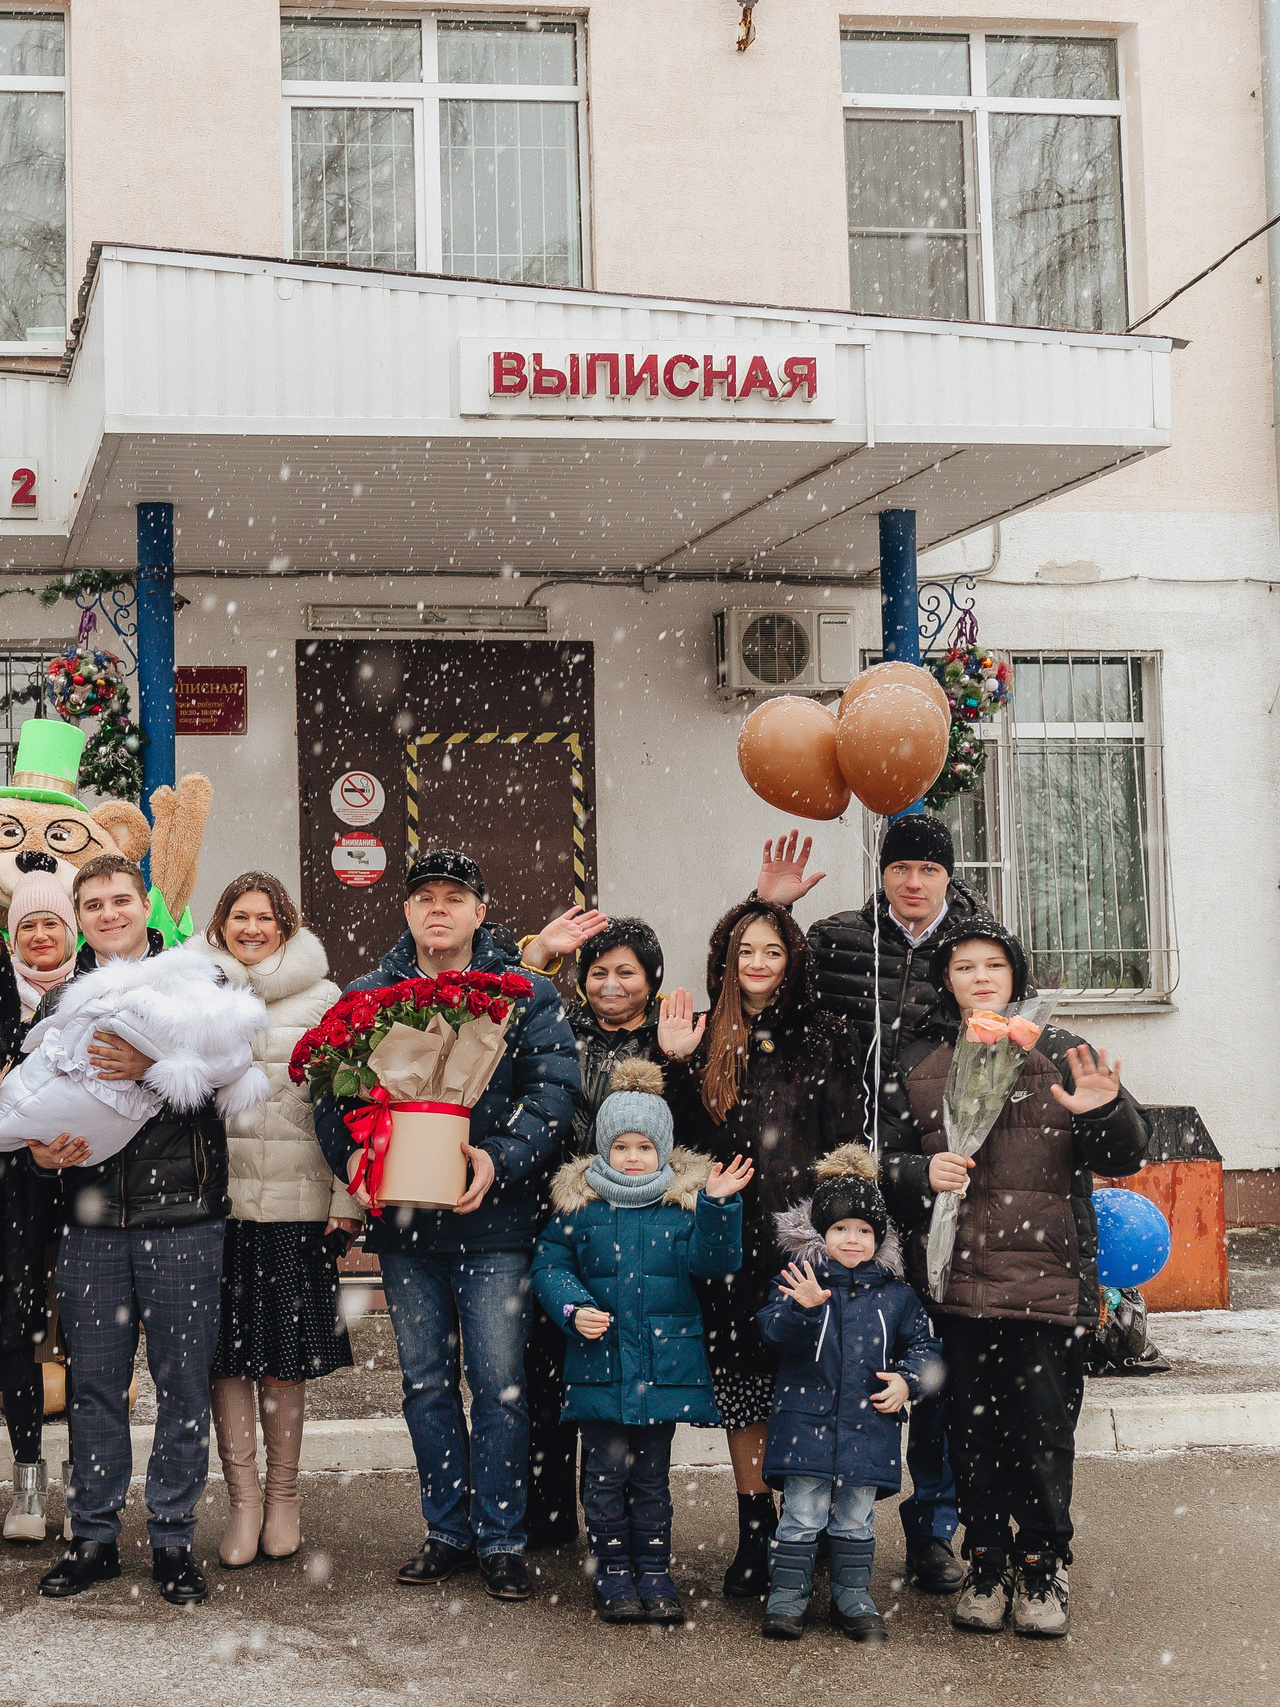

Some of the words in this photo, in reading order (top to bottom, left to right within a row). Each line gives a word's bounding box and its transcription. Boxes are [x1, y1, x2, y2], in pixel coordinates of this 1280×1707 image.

[490, 351, 818, 400] ВЫПИСНАЯ
[12, 468, 38, 505] 2
[175, 683, 237, 694] ПИСНАЯ
[342, 838, 377, 847] ВНИМАНИЕ!
